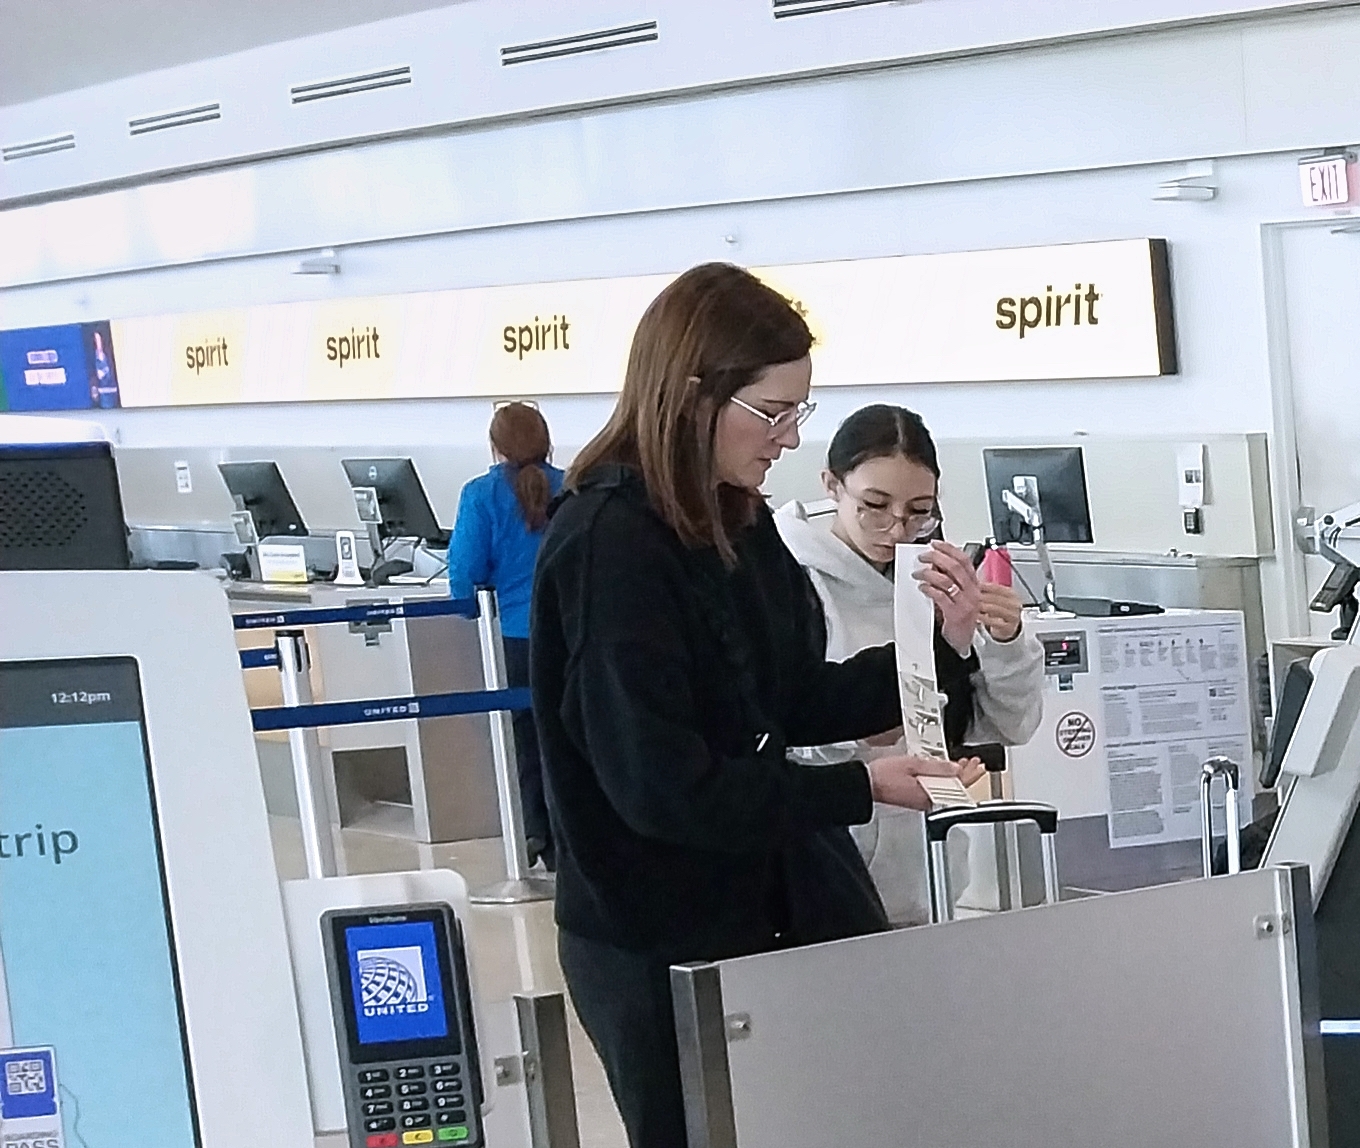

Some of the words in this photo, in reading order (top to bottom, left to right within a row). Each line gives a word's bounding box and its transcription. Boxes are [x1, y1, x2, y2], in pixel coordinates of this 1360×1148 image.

[1309, 161, 1346, 203] EXIT
[996, 282, 1100, 340] spirit
[186, 335, 229, 376] spirit
[326, 325, 380, 369] spirit
[503, 314, 571, 361] spirit
[51, 690, 111, 705] 12:12pm
[363, 1003, 430, 1018] UNITED
